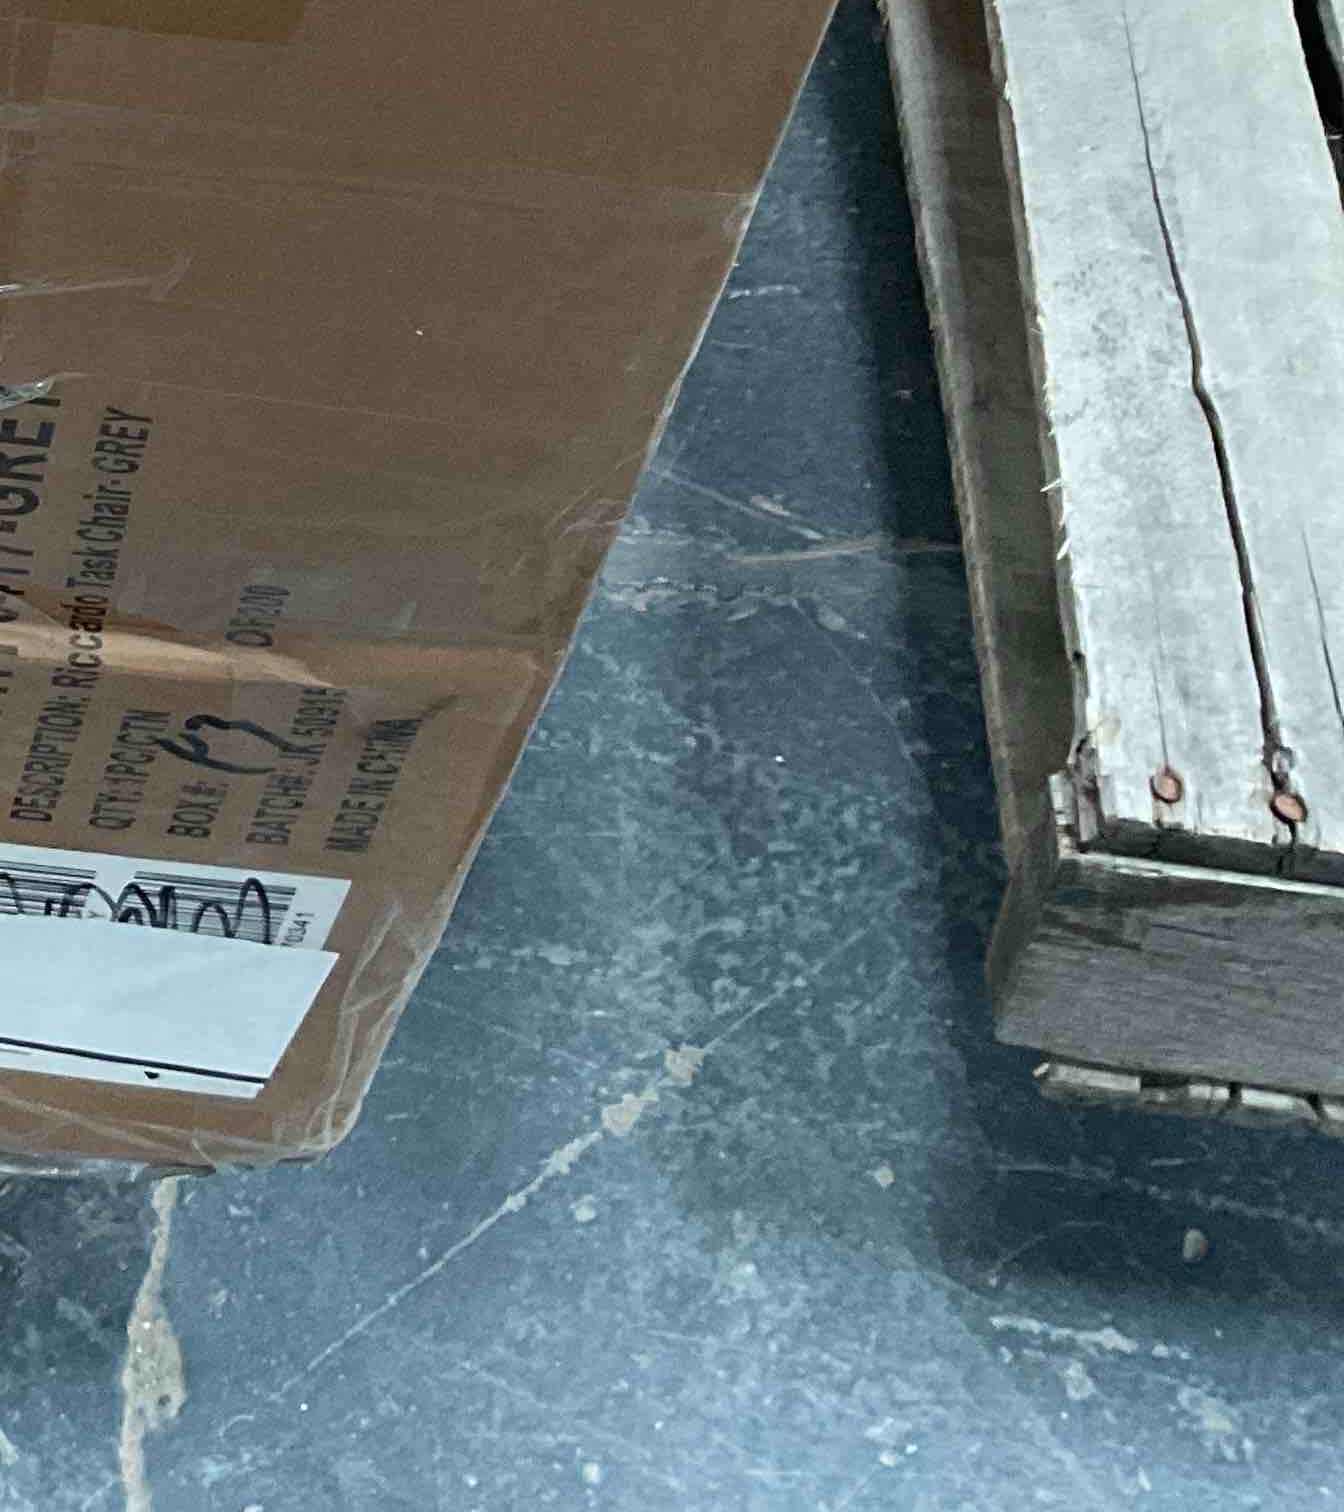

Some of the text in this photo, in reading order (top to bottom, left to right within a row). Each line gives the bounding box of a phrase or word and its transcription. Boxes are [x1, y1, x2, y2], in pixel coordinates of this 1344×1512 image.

[96, 406, 154, 478] GREY
[66, 544, 117, 592] Task
[52, 593, 109, 691] Riccardo
[12, 693, 91, 822] DESCRIPTION:
[326, 801, 380, 853] MADE
